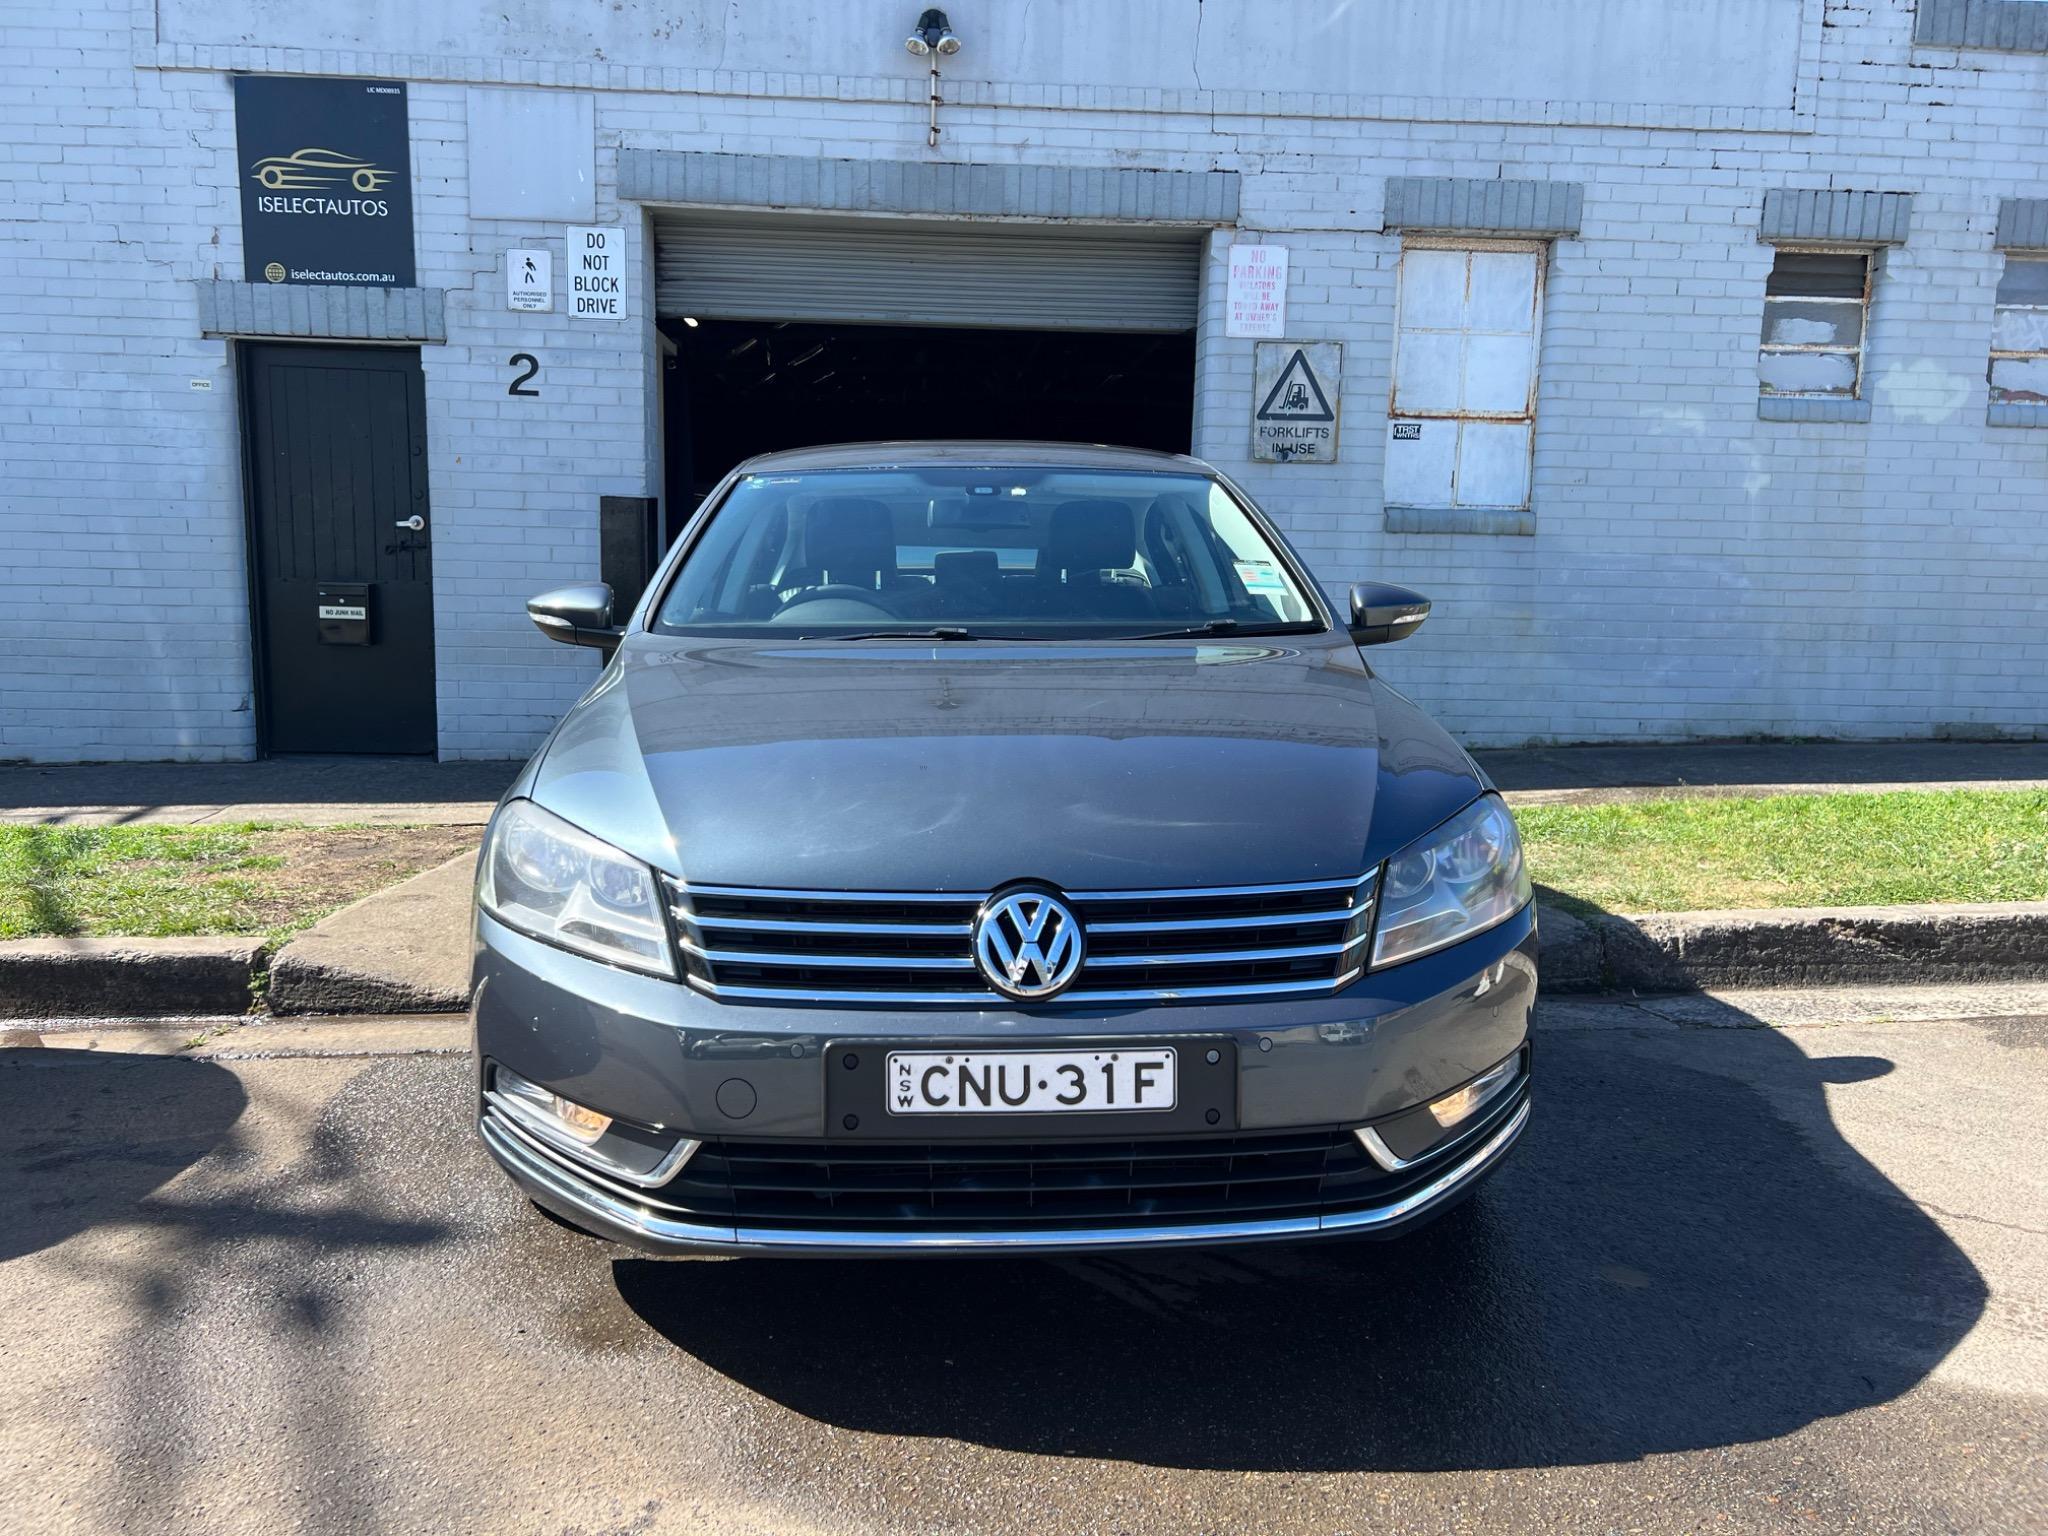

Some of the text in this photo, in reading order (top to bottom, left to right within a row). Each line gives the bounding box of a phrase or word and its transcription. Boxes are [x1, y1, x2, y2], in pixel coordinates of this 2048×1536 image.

[258, 196, 388, 216] ISELECTAUTOS
[586, 233, 606, 249] DO
[583, 255, 610, 271] NOT
[1251, 250, 1266, 263] NO
[291, 269, 395, 282] iselectautos.com.au
[1233, 265, 1283, 280] PARKING
[574, 276, 619, 293] BLOCK
[1262, 291, 1271, 302] BE
[577, 297, 617, 314] DRIVE
[1260, 302, 1280, 312] AWAY
[1234, 312, 1243, 321] AT
[508, 353, 540, 396] 2
[1259, 426, 1330, 439] FORKLIFTS
[1291, 443, 1315, 455] USE
[325, 608, 334, 616] NO
[898, 1064, 914, 1108] NSW
